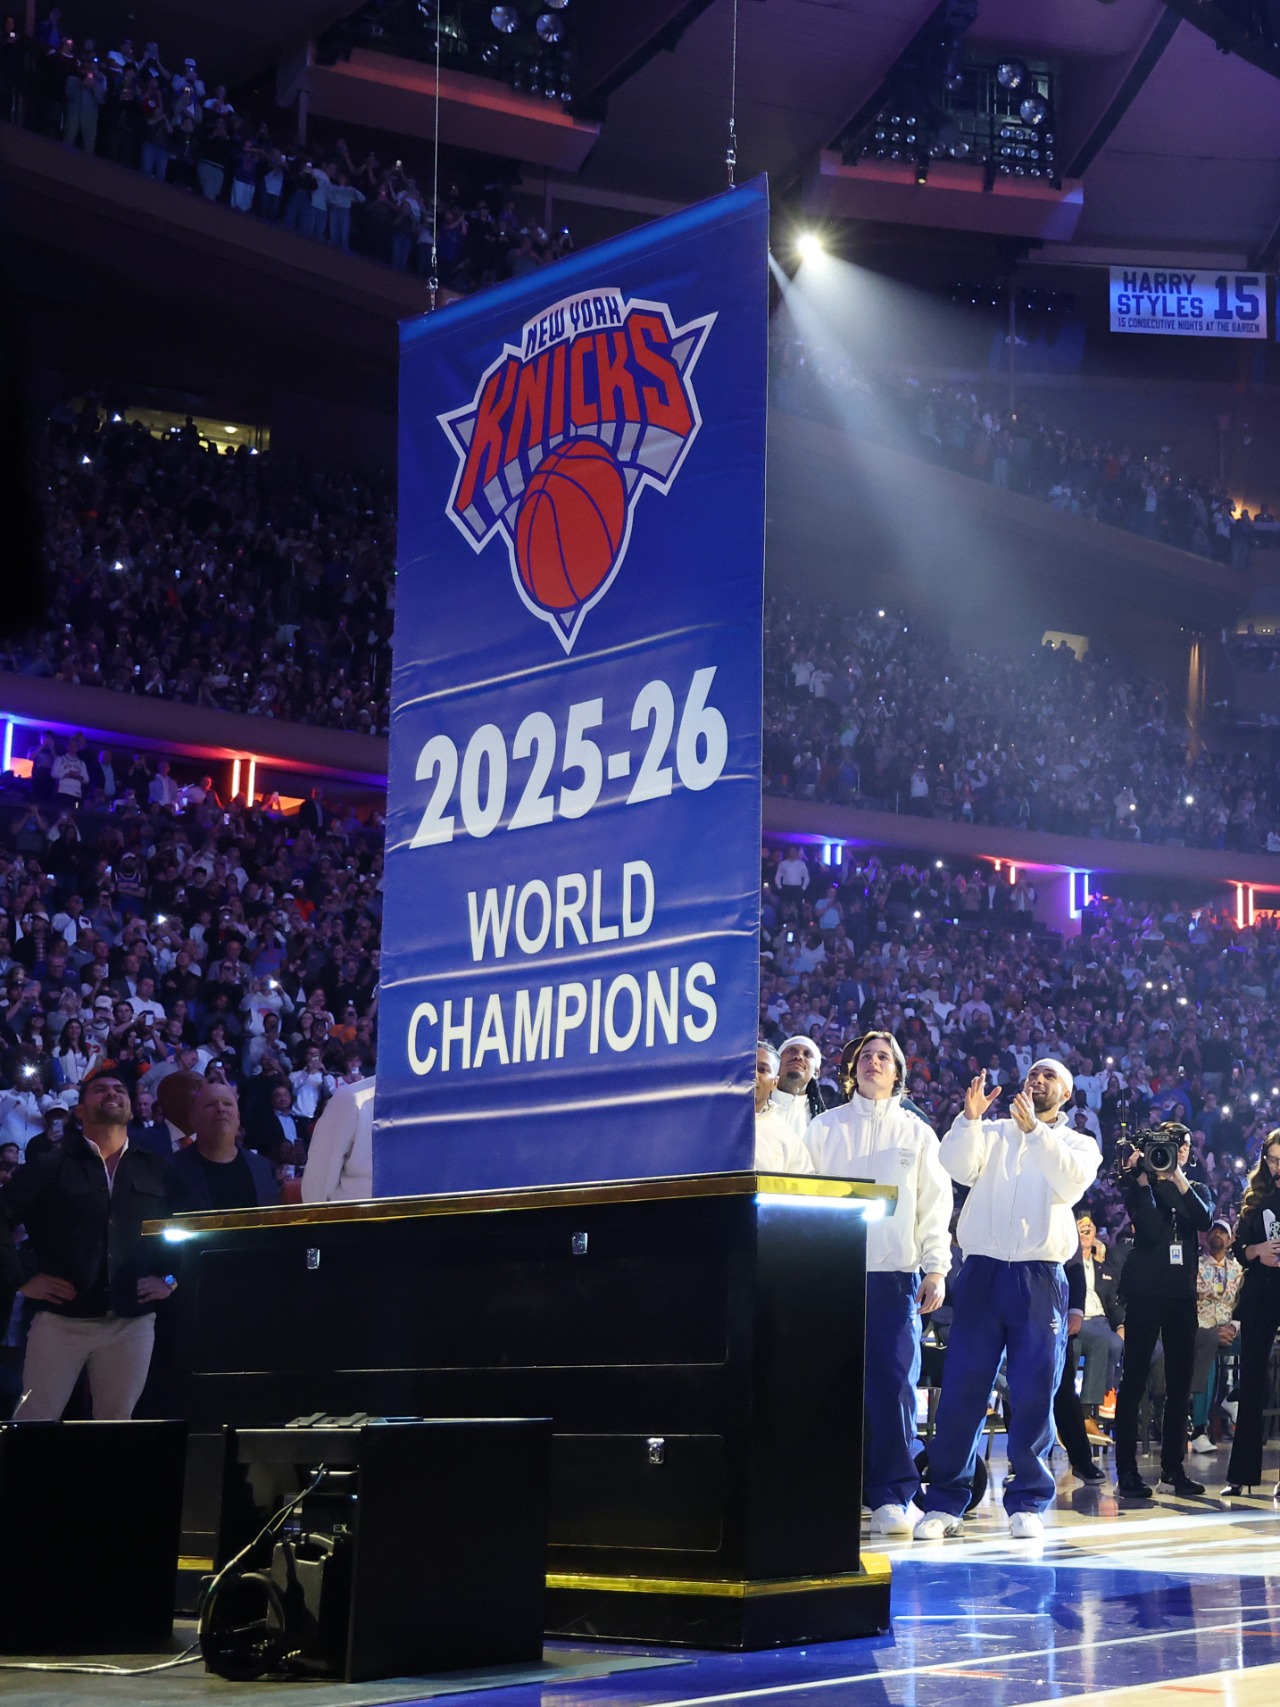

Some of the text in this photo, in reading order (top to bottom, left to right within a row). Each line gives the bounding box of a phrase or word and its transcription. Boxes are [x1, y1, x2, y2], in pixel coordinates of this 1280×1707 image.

[1117, 294, 1203, 318] STYLES
[1123, 271, 1196, 295] HARRY
[1214, 276, 1259, 320] 15
[526, 295, 621, 355] NEW YORK
[1118, 317, 1259, 333] 15 CONSECUTIVE NIGHTS AT THE GARDEN
[456, 313, 693, 512] KNICKS
[409, 665, 729, 850] 2025-26
[468, 859, 655, 962] WORLD
[407, 961, 718, 1077] CHAMPIONS
